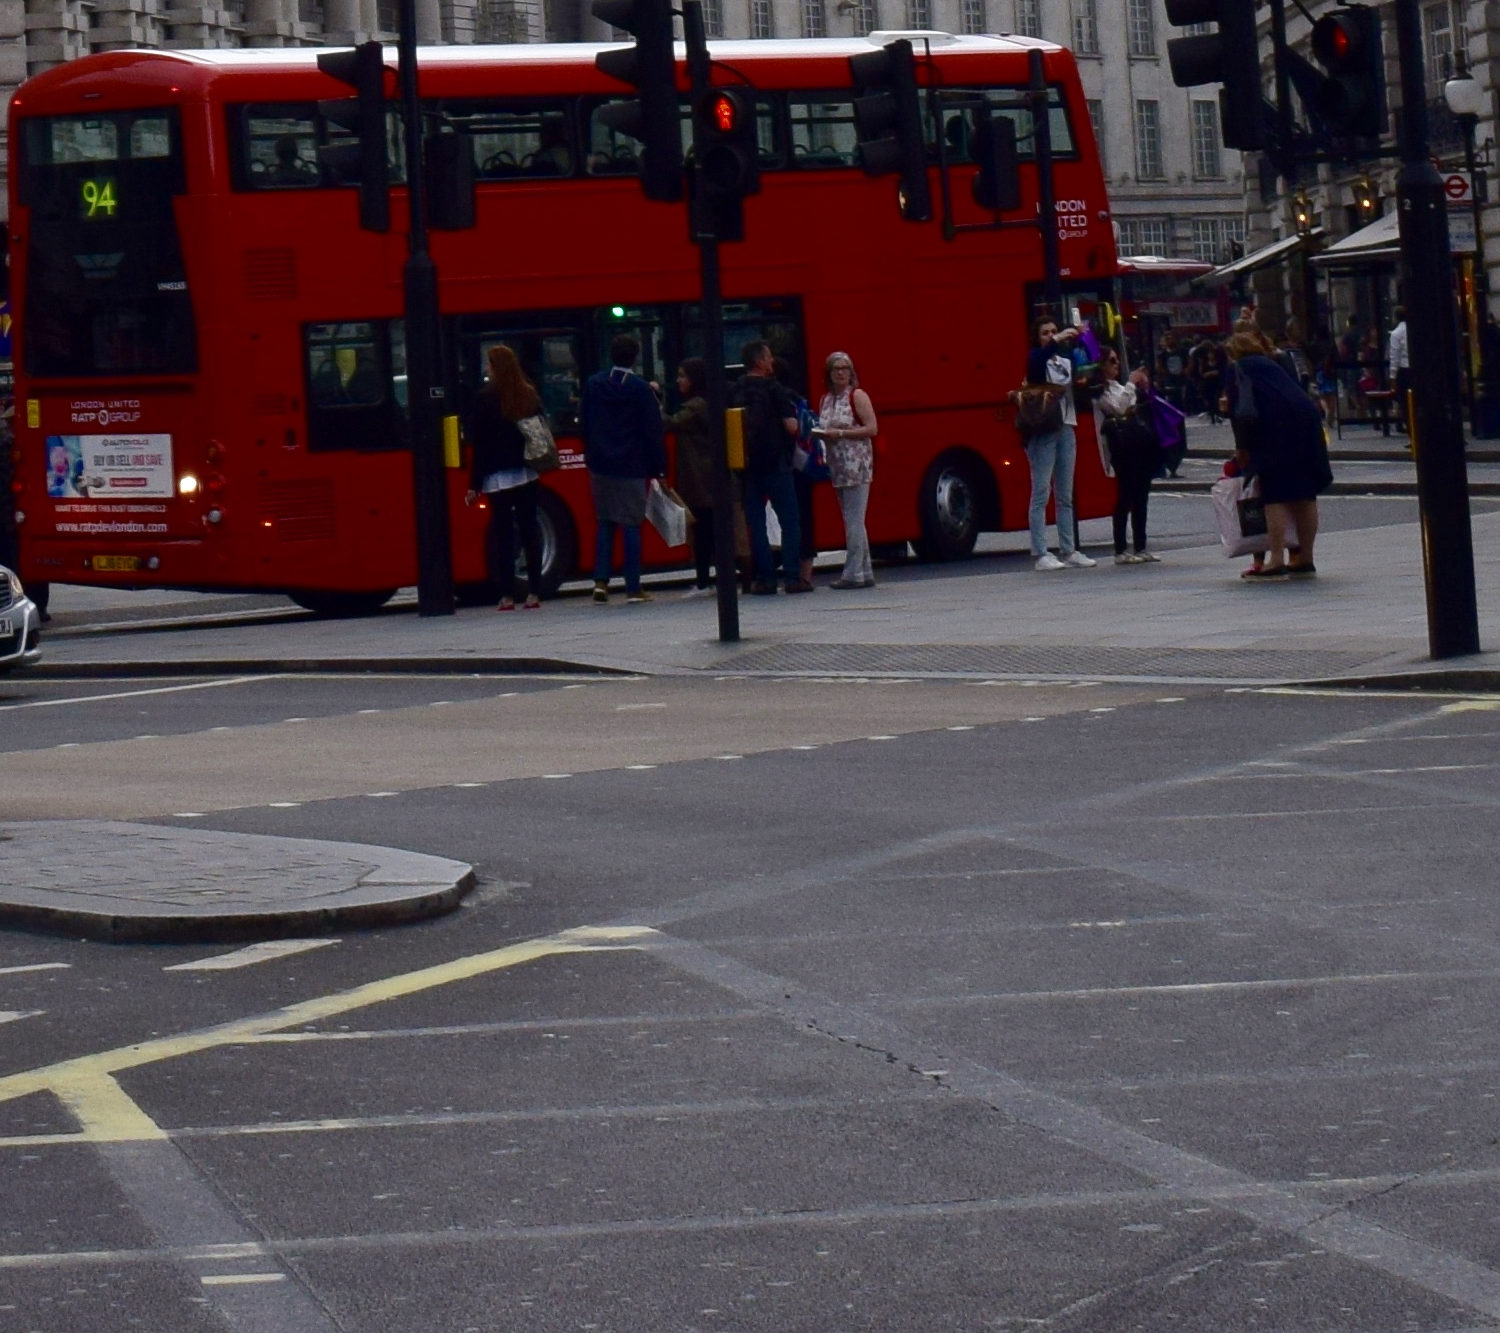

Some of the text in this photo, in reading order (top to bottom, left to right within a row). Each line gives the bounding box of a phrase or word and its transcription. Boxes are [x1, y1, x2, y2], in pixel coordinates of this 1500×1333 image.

[83, 180, 117, 217] 94
[1036, 199, 1087, 214] LNDON
[1057, 214, 1088, 228] ITED
[70, 399, 140, 409] LONDON UNITED
[71, 412, 141, 423] RATP GROUP
[116, 455, 131, 466] SELL
[55, 520, 168, 534] www.ratpdevlondon.com
